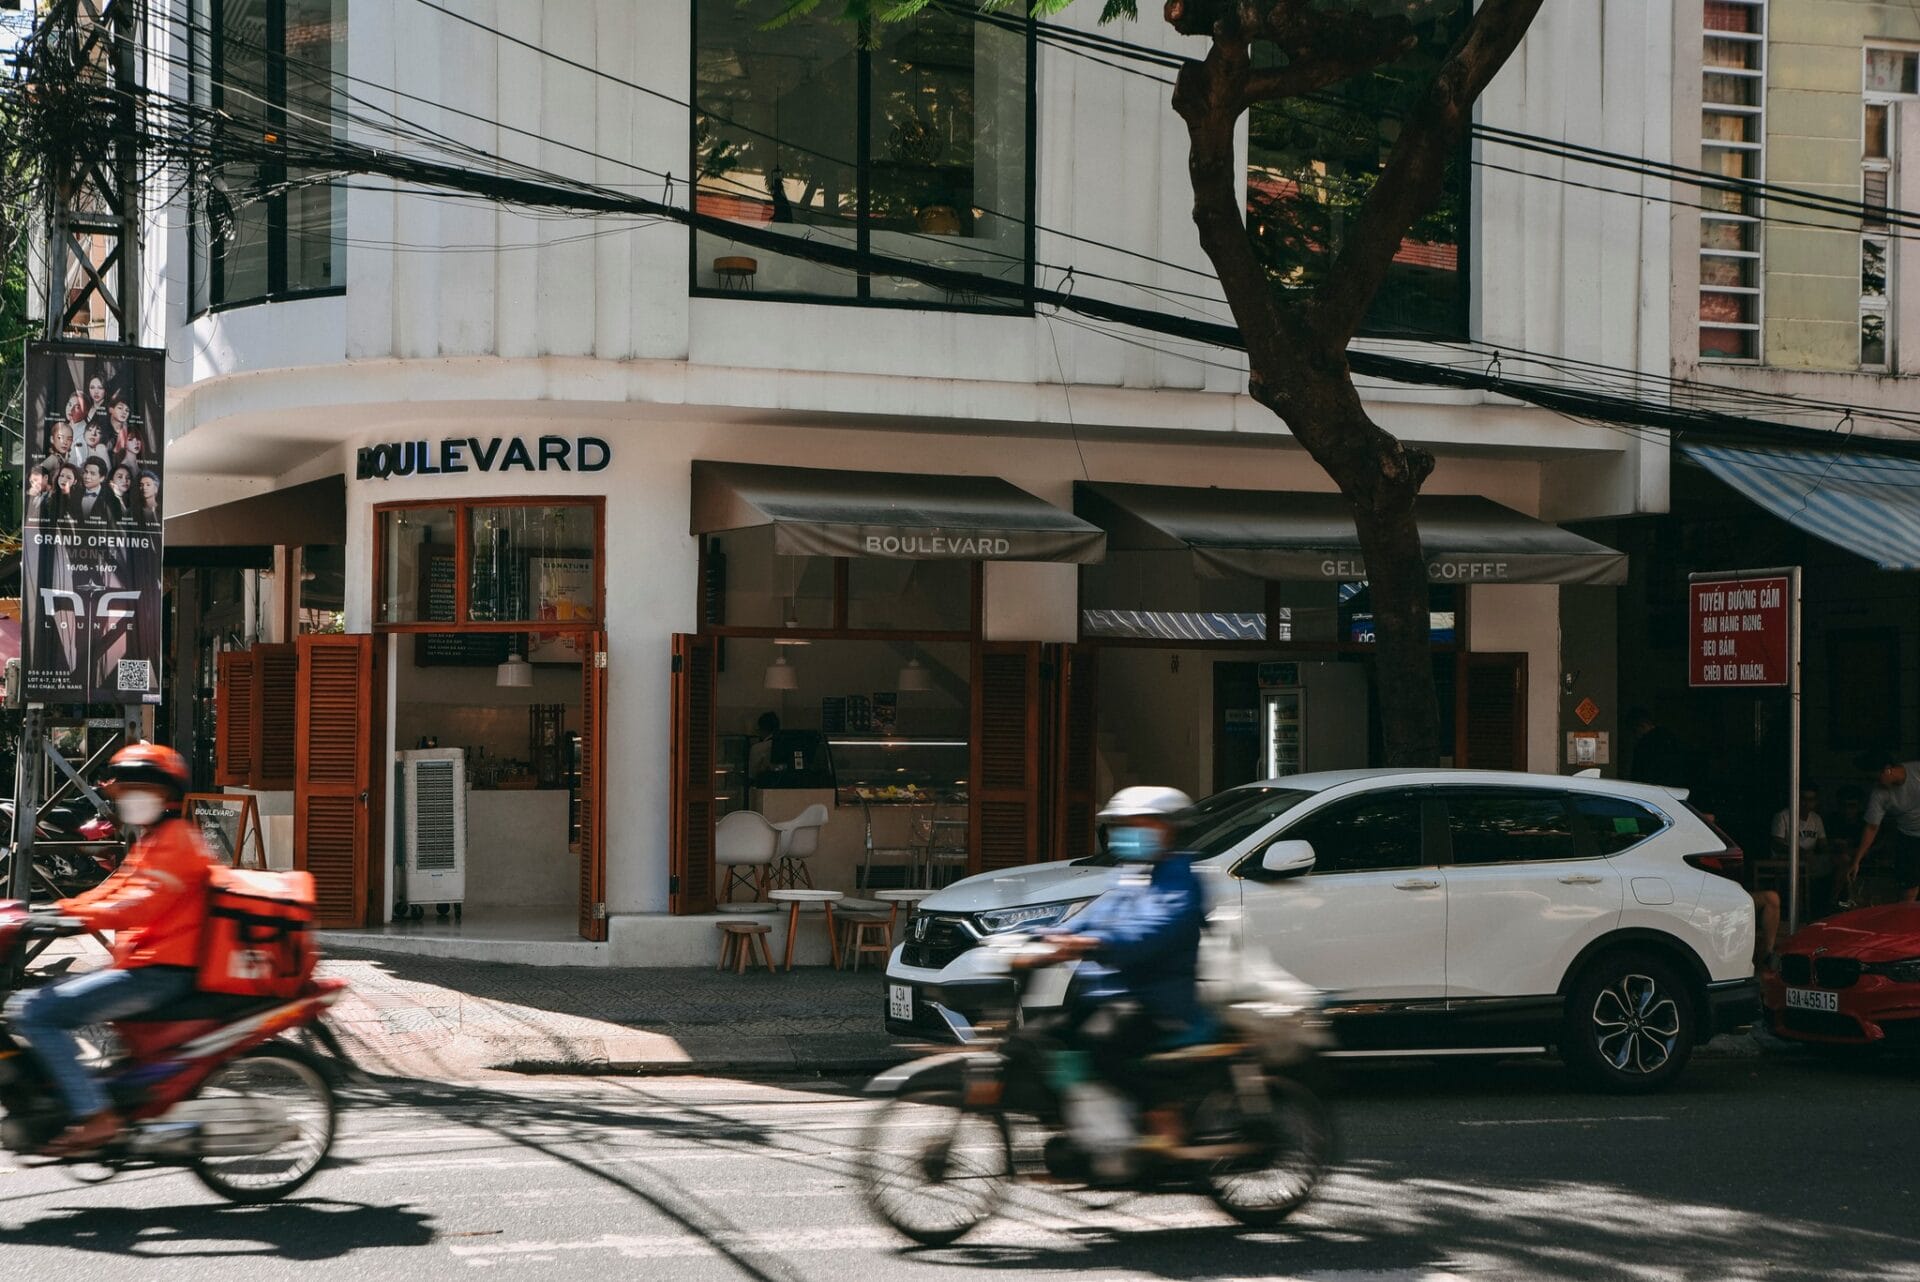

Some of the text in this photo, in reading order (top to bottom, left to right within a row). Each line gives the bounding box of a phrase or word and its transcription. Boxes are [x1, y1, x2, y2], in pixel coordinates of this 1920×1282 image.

[356, 437, 611, 480] BOULEVARD
[34, 533, 150, 548] GRAND OPENING
[866, 536, 1010, 554] BOULEVARD
[68, 548, 118, 560] MONTH
[1428, 562, 1508, 578] COFFEE
[195, 808, 235, 817] BOULEVARD
